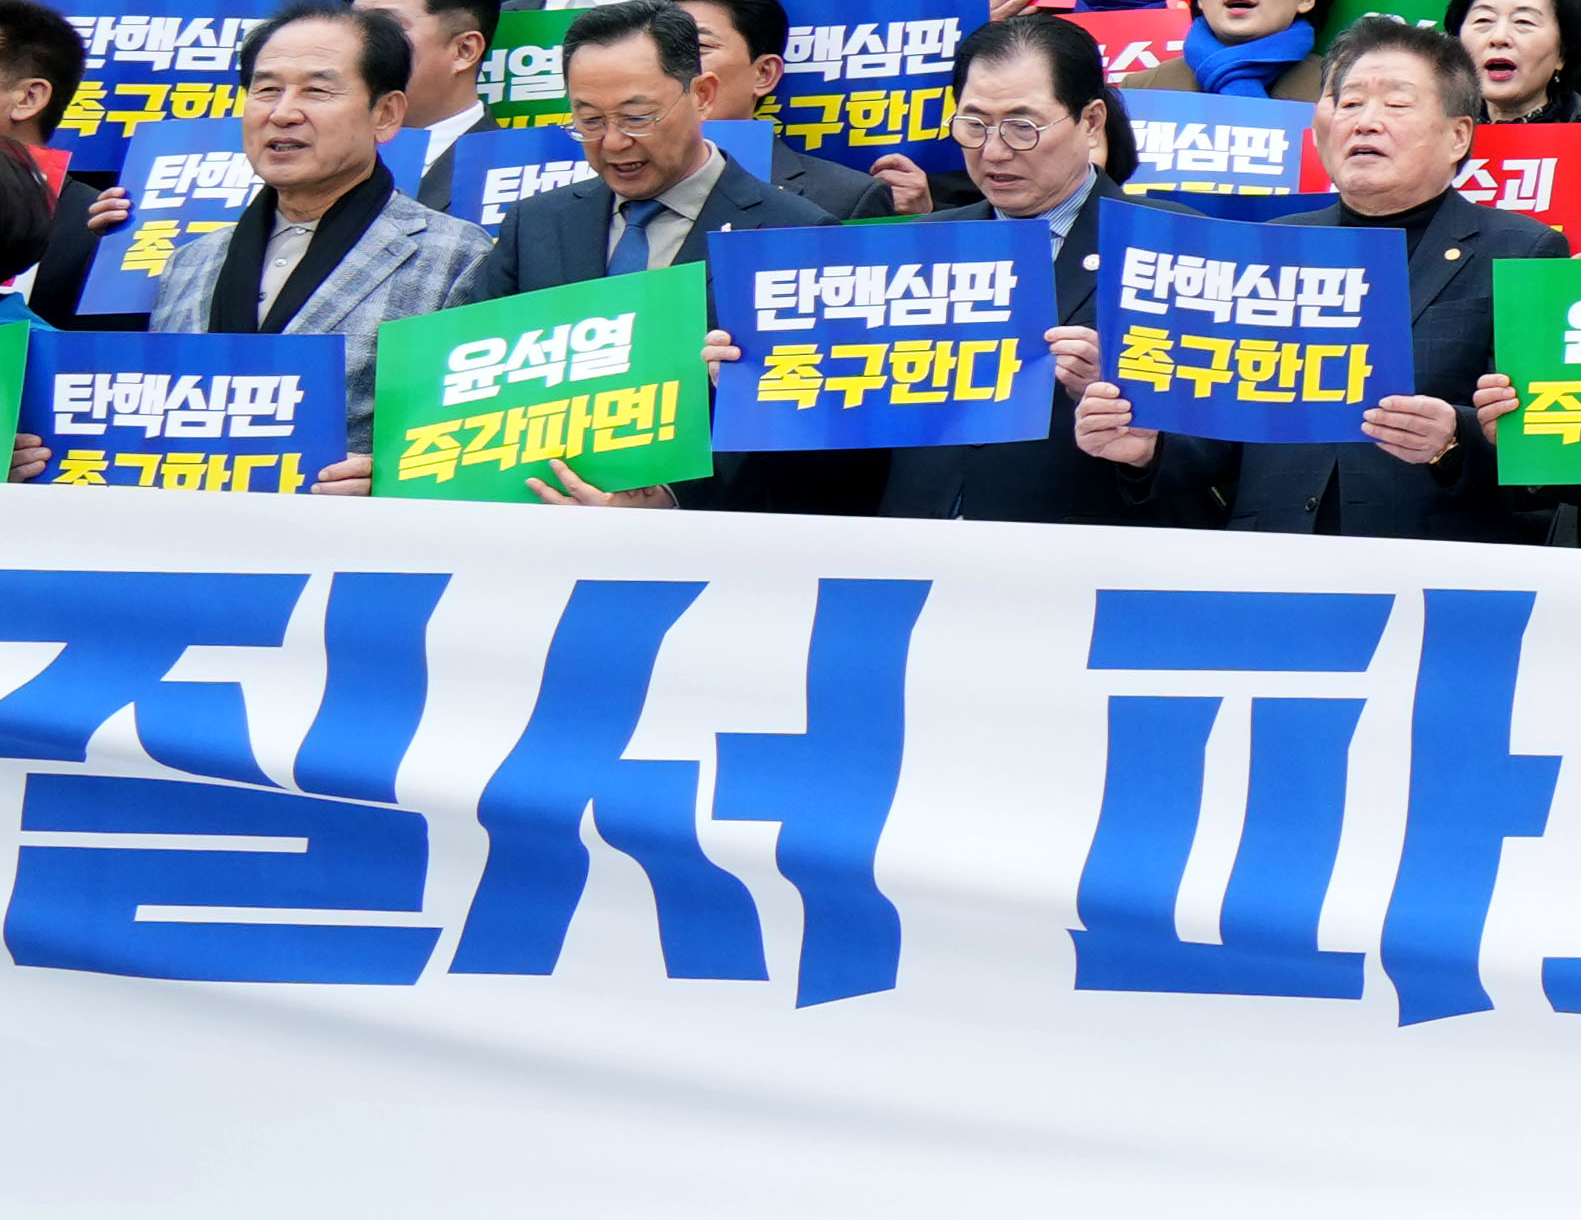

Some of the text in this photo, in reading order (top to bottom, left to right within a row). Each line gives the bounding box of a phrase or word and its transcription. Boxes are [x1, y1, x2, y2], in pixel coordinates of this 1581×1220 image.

[69, 16, 248, 71] 탄핵심
[784, 18, 959, 73] 핵심판
[1130, 118, 1288, 176] 핵심판
[753, 258, 1017, 331] 탄핵심판
[1120, 248, 1369, 328] 탄핵심판
[444, 311, 634, 404] 윤석열
[756, 336, 1021, 408] 촉구한다
[1119, 328, 1371, 404] 촉구한다
[53, 374, 302, 438] 탄핵심판
[399, 383, 676, 482] 즉각파면!
[0, 571, 934, 1007] 질서
